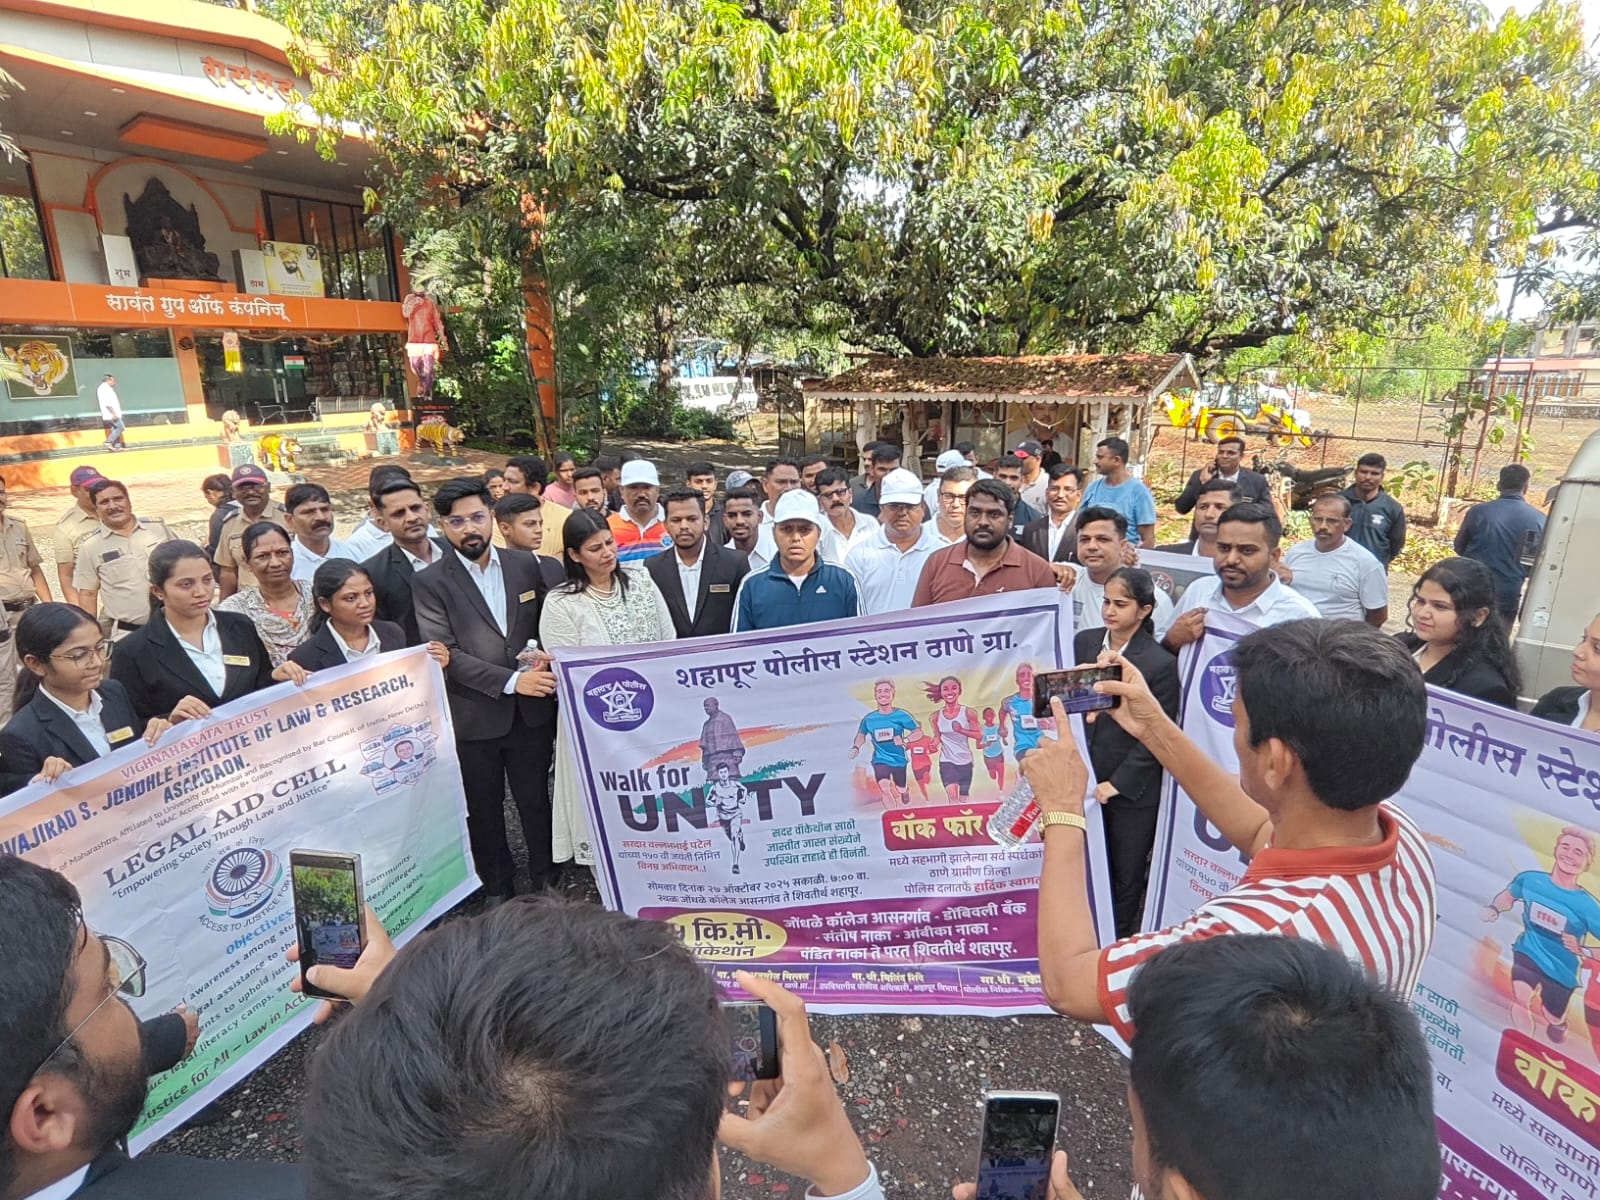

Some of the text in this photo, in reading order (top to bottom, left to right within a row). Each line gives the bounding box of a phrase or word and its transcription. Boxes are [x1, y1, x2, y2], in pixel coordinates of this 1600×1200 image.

[114, 268, 131, 281] शुभ
[106, 291, 155, 312] सावंत
[160, 297, 184, 318] ग्रुप
[188, 294, 224, 315] ऑफ
[676, 628, 1018, 688] शहापूर पोलीस स्टेशन ठाणे ग्रा.
[225, 708, 271, 732] TRUST
[79, 801, 97, 820] S.
[102, 766, 173, 811] JONDHLE
[254, 722, 274, 742] OF
[277, 707, 311, 733] LAW
[315, 703, 327, 718] &
[331, 674, 414, 713] RESEARCH,
[69, 835, 119, 866] Maharashtra,
[154, 809, 162, 820] to
[163, 793, 200, 816] University
[201, 787, 210, 796] of
[211, 775, 242, 791] Mumbai
[244, 767, 257, 778] and
[259, 749, 302, 770] Recognised
[303, 743, 312, 756] by
[313, 739, 326, 748] Bar
[327, 727, 356, 742] Council
[357, 722, 365, 731] of
[388, 711, 403, 720] New
[600, 765, 690, 792] Walk for
[156, 818, 178, 829] NAAC
[179, 794, 219, 817] Accredited
[221, 785, 239, 797] with
[251, 769, 273, 782] Grade
[103, 822, 207, 888] LEGAL
[212, 793, 264, 829] AID
[272, 757, 347, 796] CELL
[771, 827, 792, 838] सदर
[834, 818, 856, 831] साठी
[890, 808, 984, 841] वॉक फॉर
[112, 858, 179, 899] "Empowering
[179, 838, 212, 862] Society
[213, 817, 254, 842] Through
[255, 808, 274, 821] Law
[277, 798, 294, 812] and
[295, 778, 332, 803] Justice"
[622, 840, 646, 849] सरदार
[690, 838, 713, 849] पटेल
[766, 831, 861, 852] जास्तीत जास्त संख्येने
[618, 850, 720, 862] यांच्या १५० वी जयंती निमित्त
[763, 853, 799, 867] उपस्थित
[828, 848, 837, 859] ही
[839, 846, 870, 859] विनंती.
[888, 847, 1043, 867] मध्ये सहभागी झालेल्या सर्व स्पर्धकां
[1184, 848, 1209, 868] सरदार
[647, 881, 676, 892] सोमवार
[678, 882, 705, 893] दिनांक
[707, 885, 720, 893] २७
[723, 881, 761, 893] ऑक्टोबर
[764, 880, 790, 889] २०२५
[856, 872, 869, 880] वा.
[928, 864, 1011, 878] ठाणे ग्रामीण जिल्हा
[1175, 857, 1197, 877] यांच्या
[1199, 871, 1216, 886] १५०
[680, 894, 706, 904] जोंधळे
[708, 894, 736, 904] कॉलेज
[739, 894, 780, 905] आसनगांव
[783, 892, 790, 903] ते
[792, 886, 828, 901] शिवतीर्थ
[830, 886, 862, 898] शहापूर.
[904, 879, 1006, 894] पोलिस दलातर्फे हार्दिक
[198, 913, 228, 933] ACCESS
[231, 923, 242, 931] TO
[243, 898, 280, 928] JUSTICE
[783, 899, 1027, 929] जोंधळे कॉलेज आसनगांव डोंबिवली बँक
[692, 917, 771, 941] कि.मी.
[822, 922, 989, 943] संतोष नाका आंबीका नाका
[693, 941, 756, 957] ॉकेथॉन
[800, 938, 1017, 961] पंडित नाका ते परत शिवतीर्थ शहापूर.
[189, 959, 240, 1001] awareness
[243, 935, 277, 960] among
[216, 960, 265, 1000] assistance
[267, 952, 279, 963] to
[199, 975, 269, 1033] ents to uphold
[1427, 988, 1460, 1017] साठी
[191, 1009, 281, 1086] for All Law in
[200, 1020, 240, 1052] literacy
[1424, 1026, 1466, 1064] विनंती.
[1436, 1071, 1453, 1093] वा.
[1514, 1047, 1600, 1123] वॉक
[1491, 1091, 1526, 1123] मध्ये
[1499, 1142, 1560, 1194] पोलिस
[1555, 1157, 1599, 1198] ठाणे
